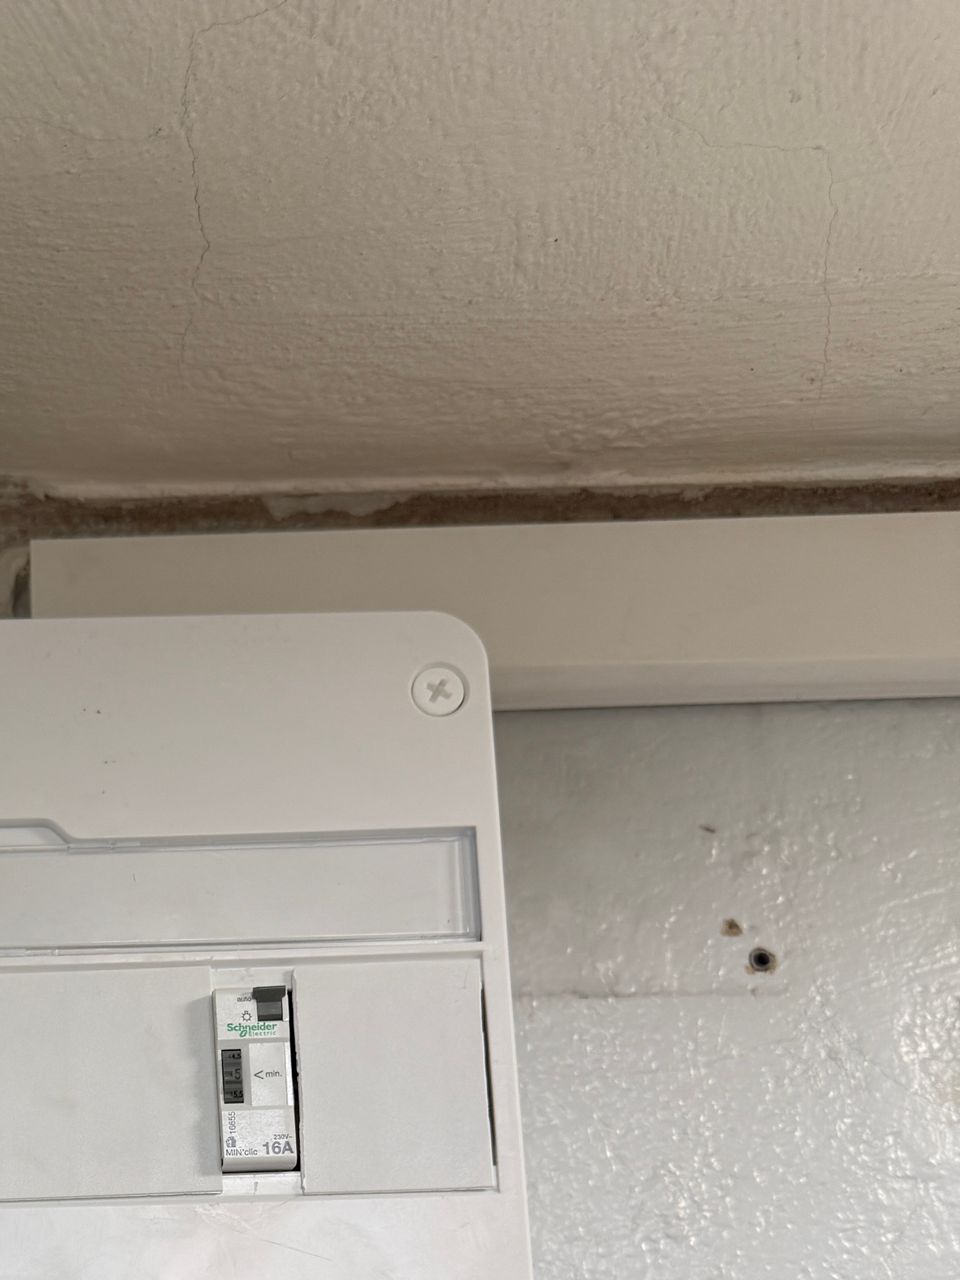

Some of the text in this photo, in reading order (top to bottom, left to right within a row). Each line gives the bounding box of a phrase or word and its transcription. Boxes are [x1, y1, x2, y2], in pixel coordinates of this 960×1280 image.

[226, 1022, 277, 1032] Schneider
[234, 1068, 241, 1080] 5
[262, 1140, 295, 1155] 16A
